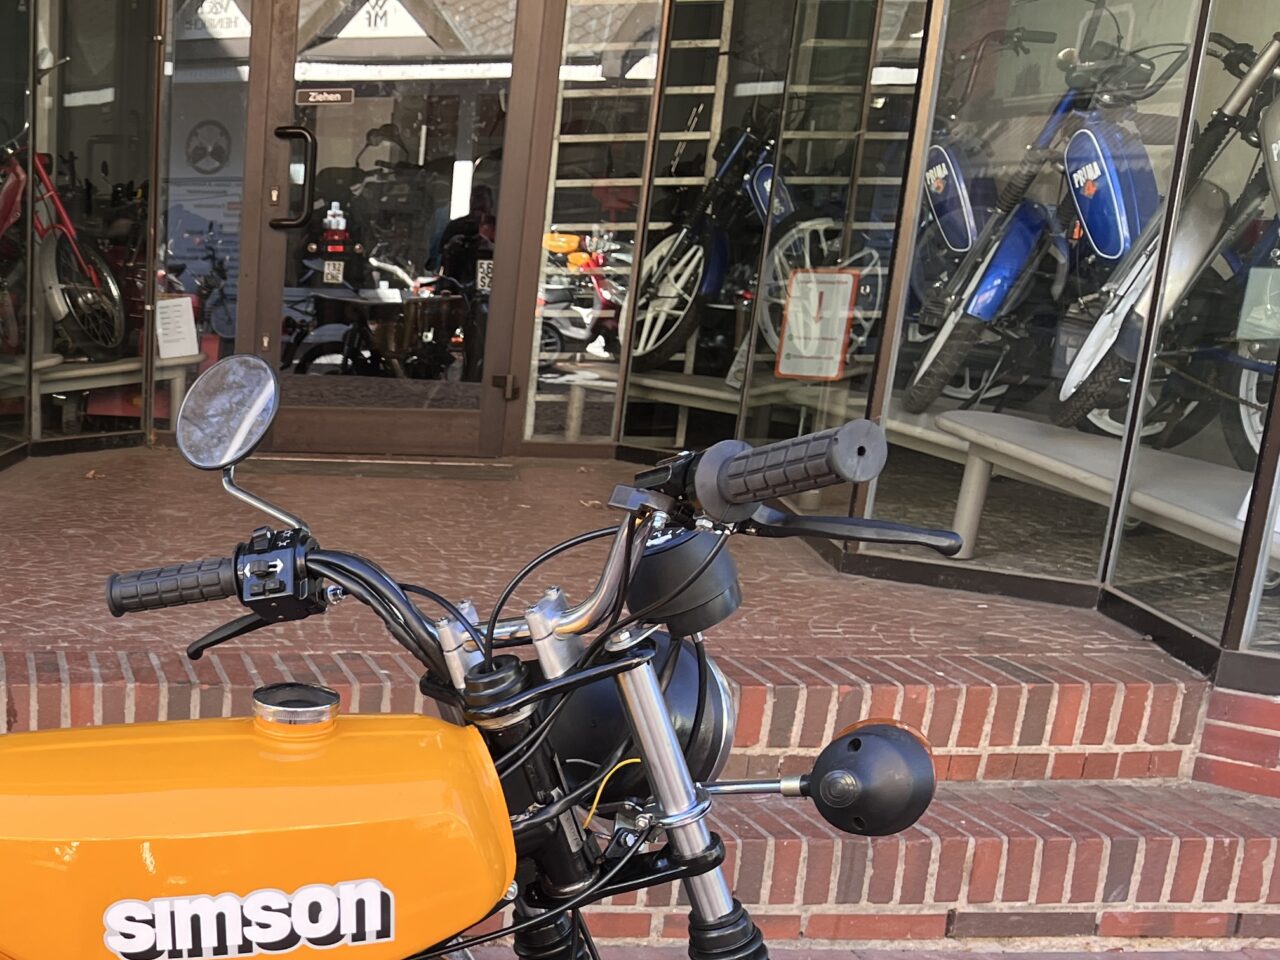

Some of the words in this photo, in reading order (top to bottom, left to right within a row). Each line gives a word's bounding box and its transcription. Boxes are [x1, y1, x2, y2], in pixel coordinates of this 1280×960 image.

[308, 91, 342, 103] Ziehen
[925, 162, 949, 185] PRIMA
[1073, 161, 1102, 188] PRIMA
